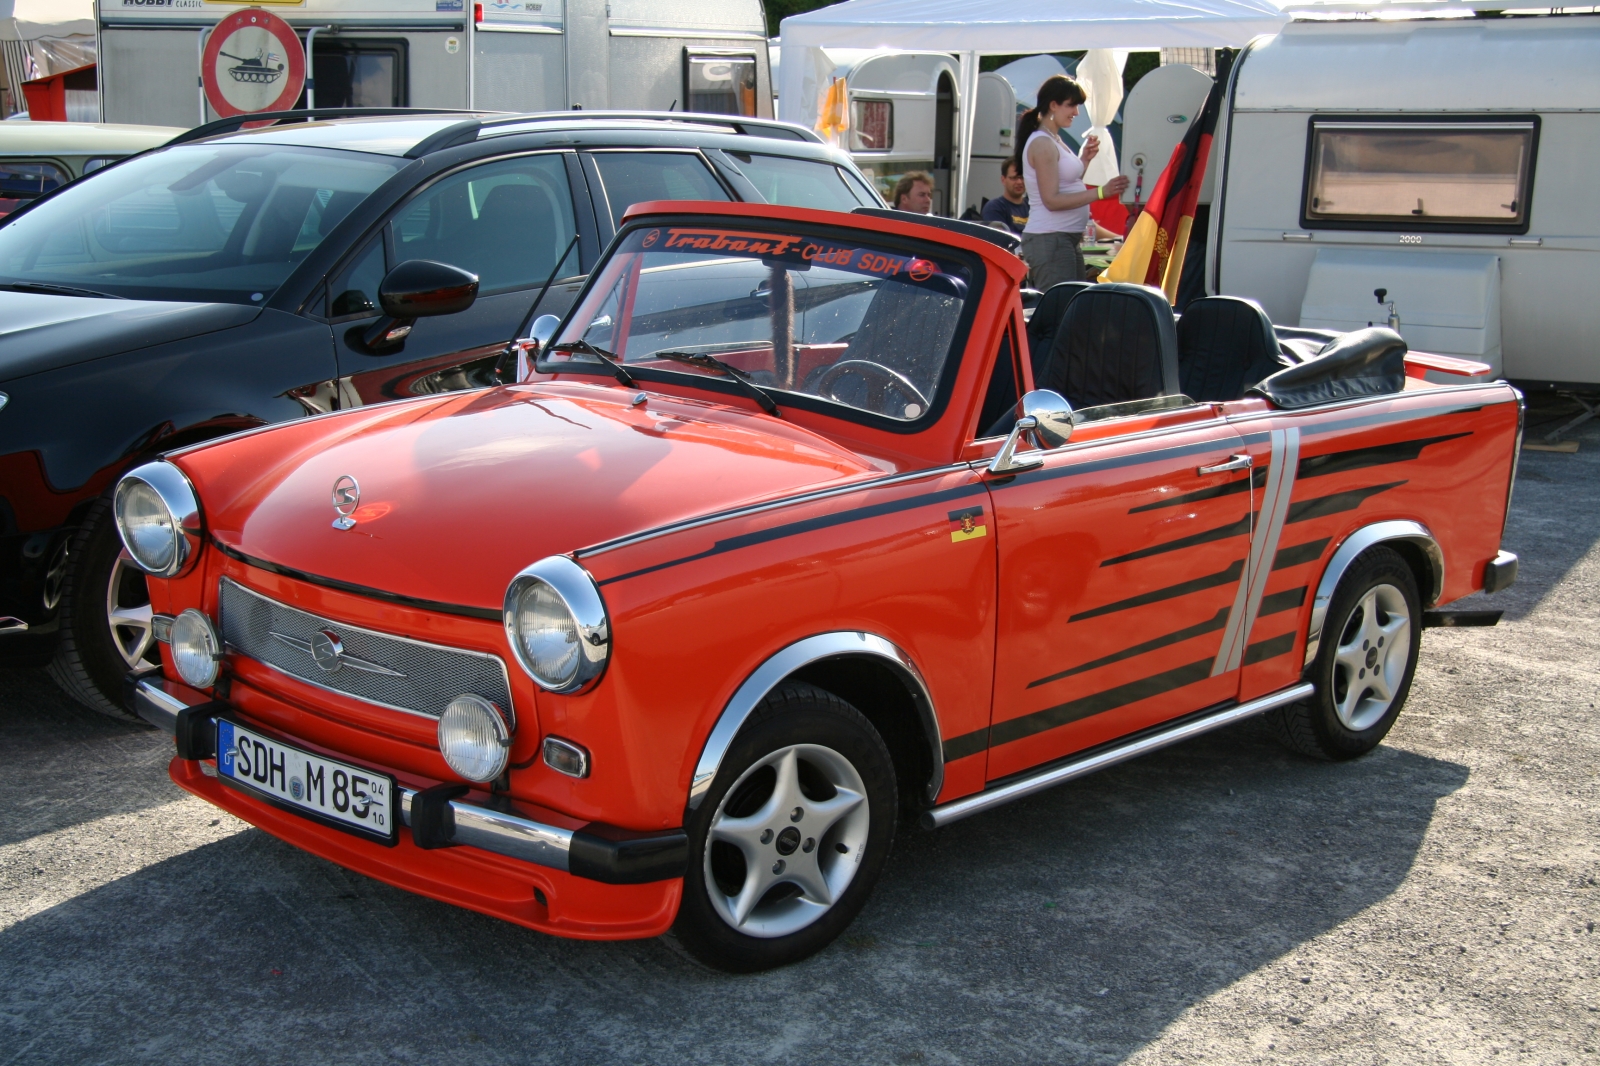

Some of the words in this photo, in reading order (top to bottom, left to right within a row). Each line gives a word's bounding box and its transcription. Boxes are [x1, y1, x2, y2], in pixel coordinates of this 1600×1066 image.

[175, 0, 202, 8] CLASSIC
[525, 3, 543, 12] HOBBY
[1399, 234, 1422, 244] 2000
[857, 252, 904, 276] SDH
[237, 735, 286, 792] SDH
[306, 760, 325, 807] M
[332, 769, 371, 819] 85
[371, 781, 385, 796] 04
[372, 811, 385, 826] 10
